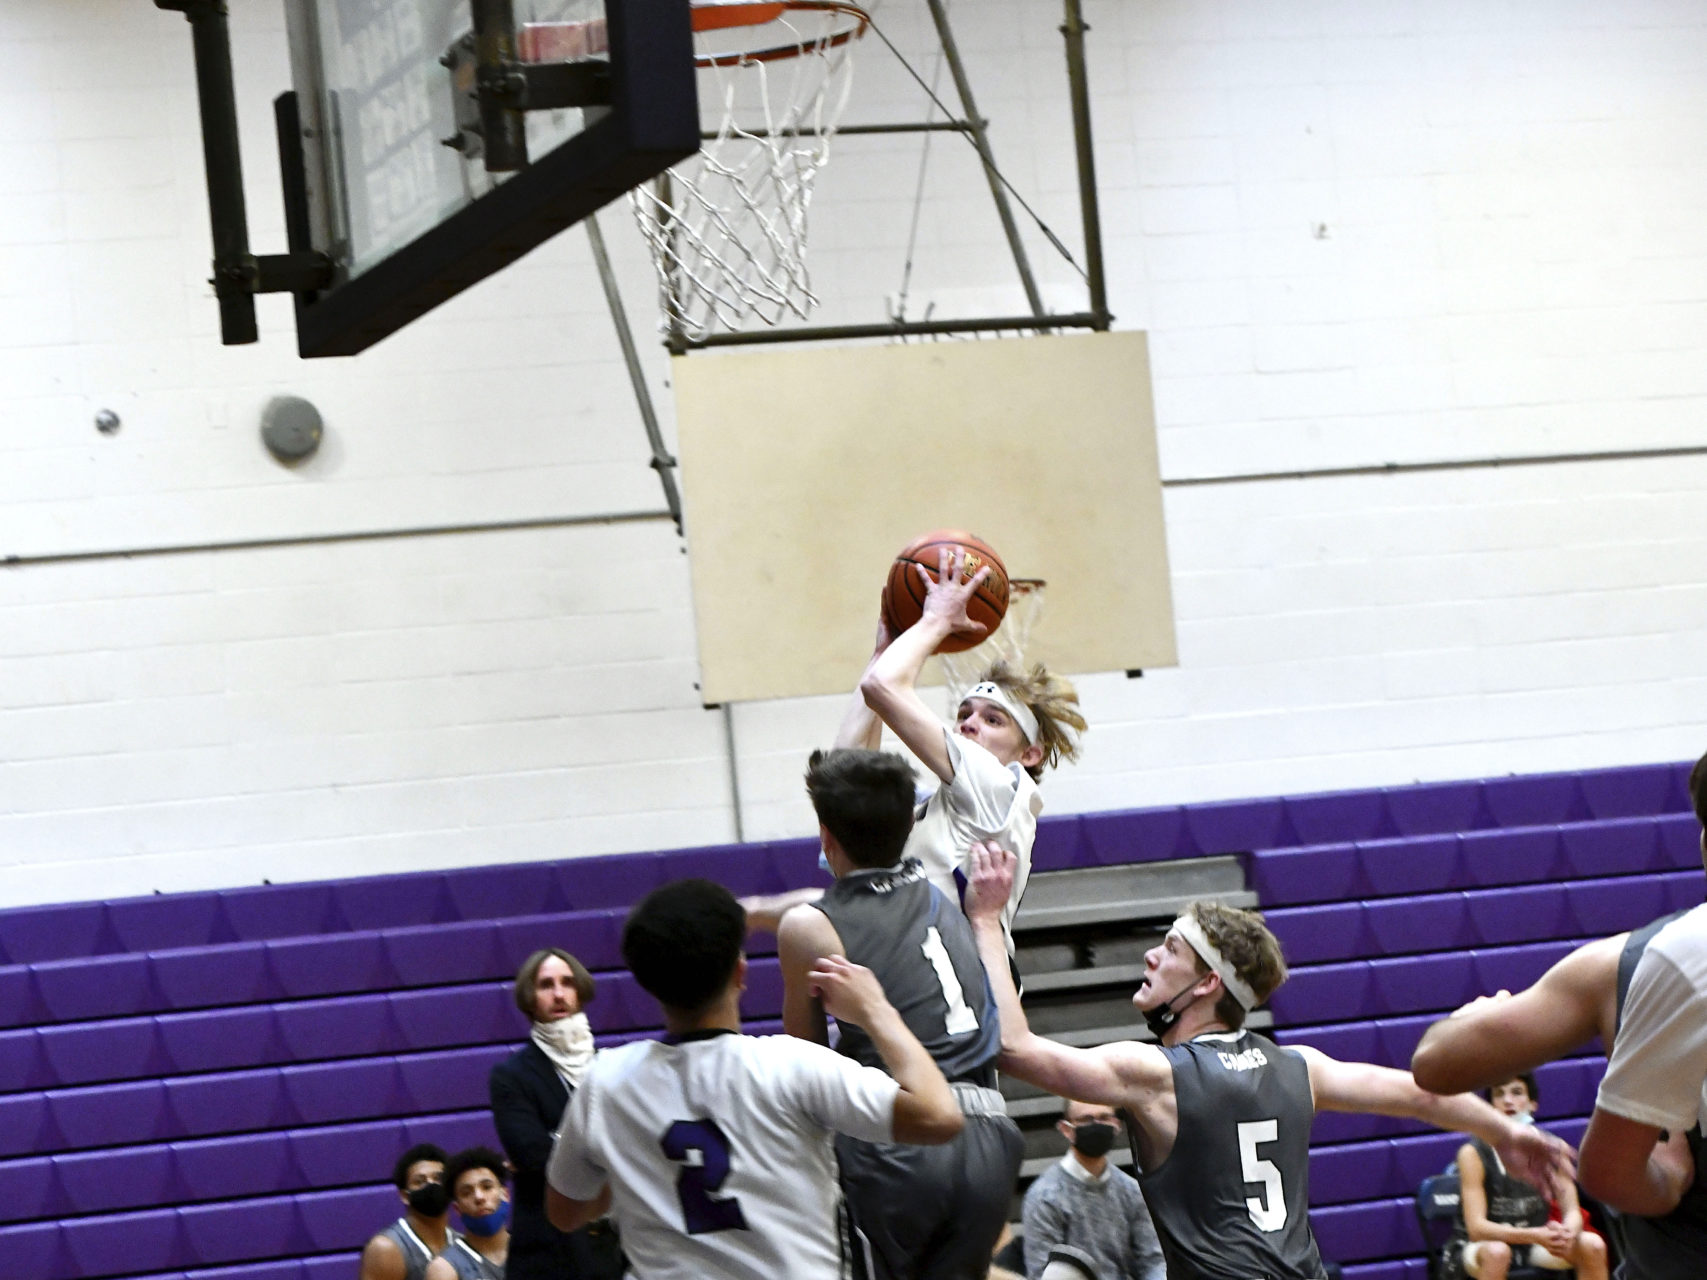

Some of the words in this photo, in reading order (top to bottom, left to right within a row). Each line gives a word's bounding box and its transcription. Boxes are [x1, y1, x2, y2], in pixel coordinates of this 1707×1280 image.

[920, 926, 980, 1034] 1
[660, 1118, 750, 1235] 2
[1237, 1119, 1288, 1232] 5
